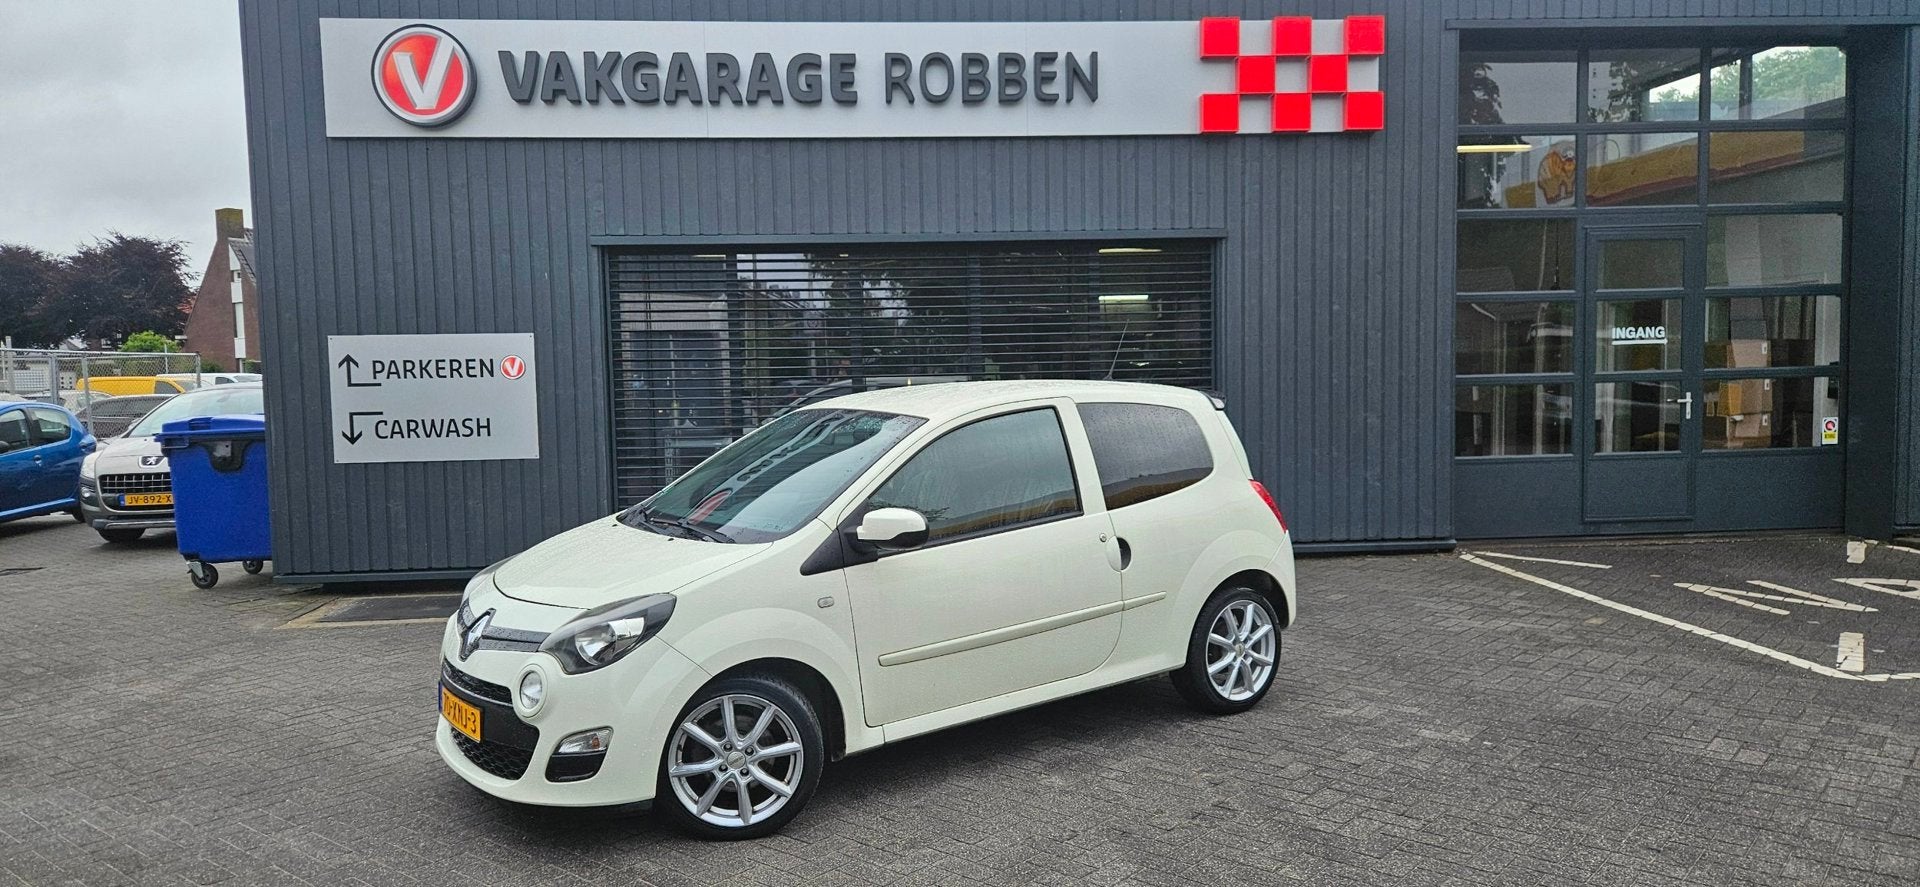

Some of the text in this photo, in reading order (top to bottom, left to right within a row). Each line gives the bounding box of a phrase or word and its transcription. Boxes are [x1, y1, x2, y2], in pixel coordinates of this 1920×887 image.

[392, 35, 1099, 110] V VAKGARAGE ROBBEN
[1611, 326, 1666, 339] INGANG
[372, 358, 495, 380] PARKEREN
[374, 417, 492, 440] CARWASH
[128, 495, 172, 505] JV-892-X
